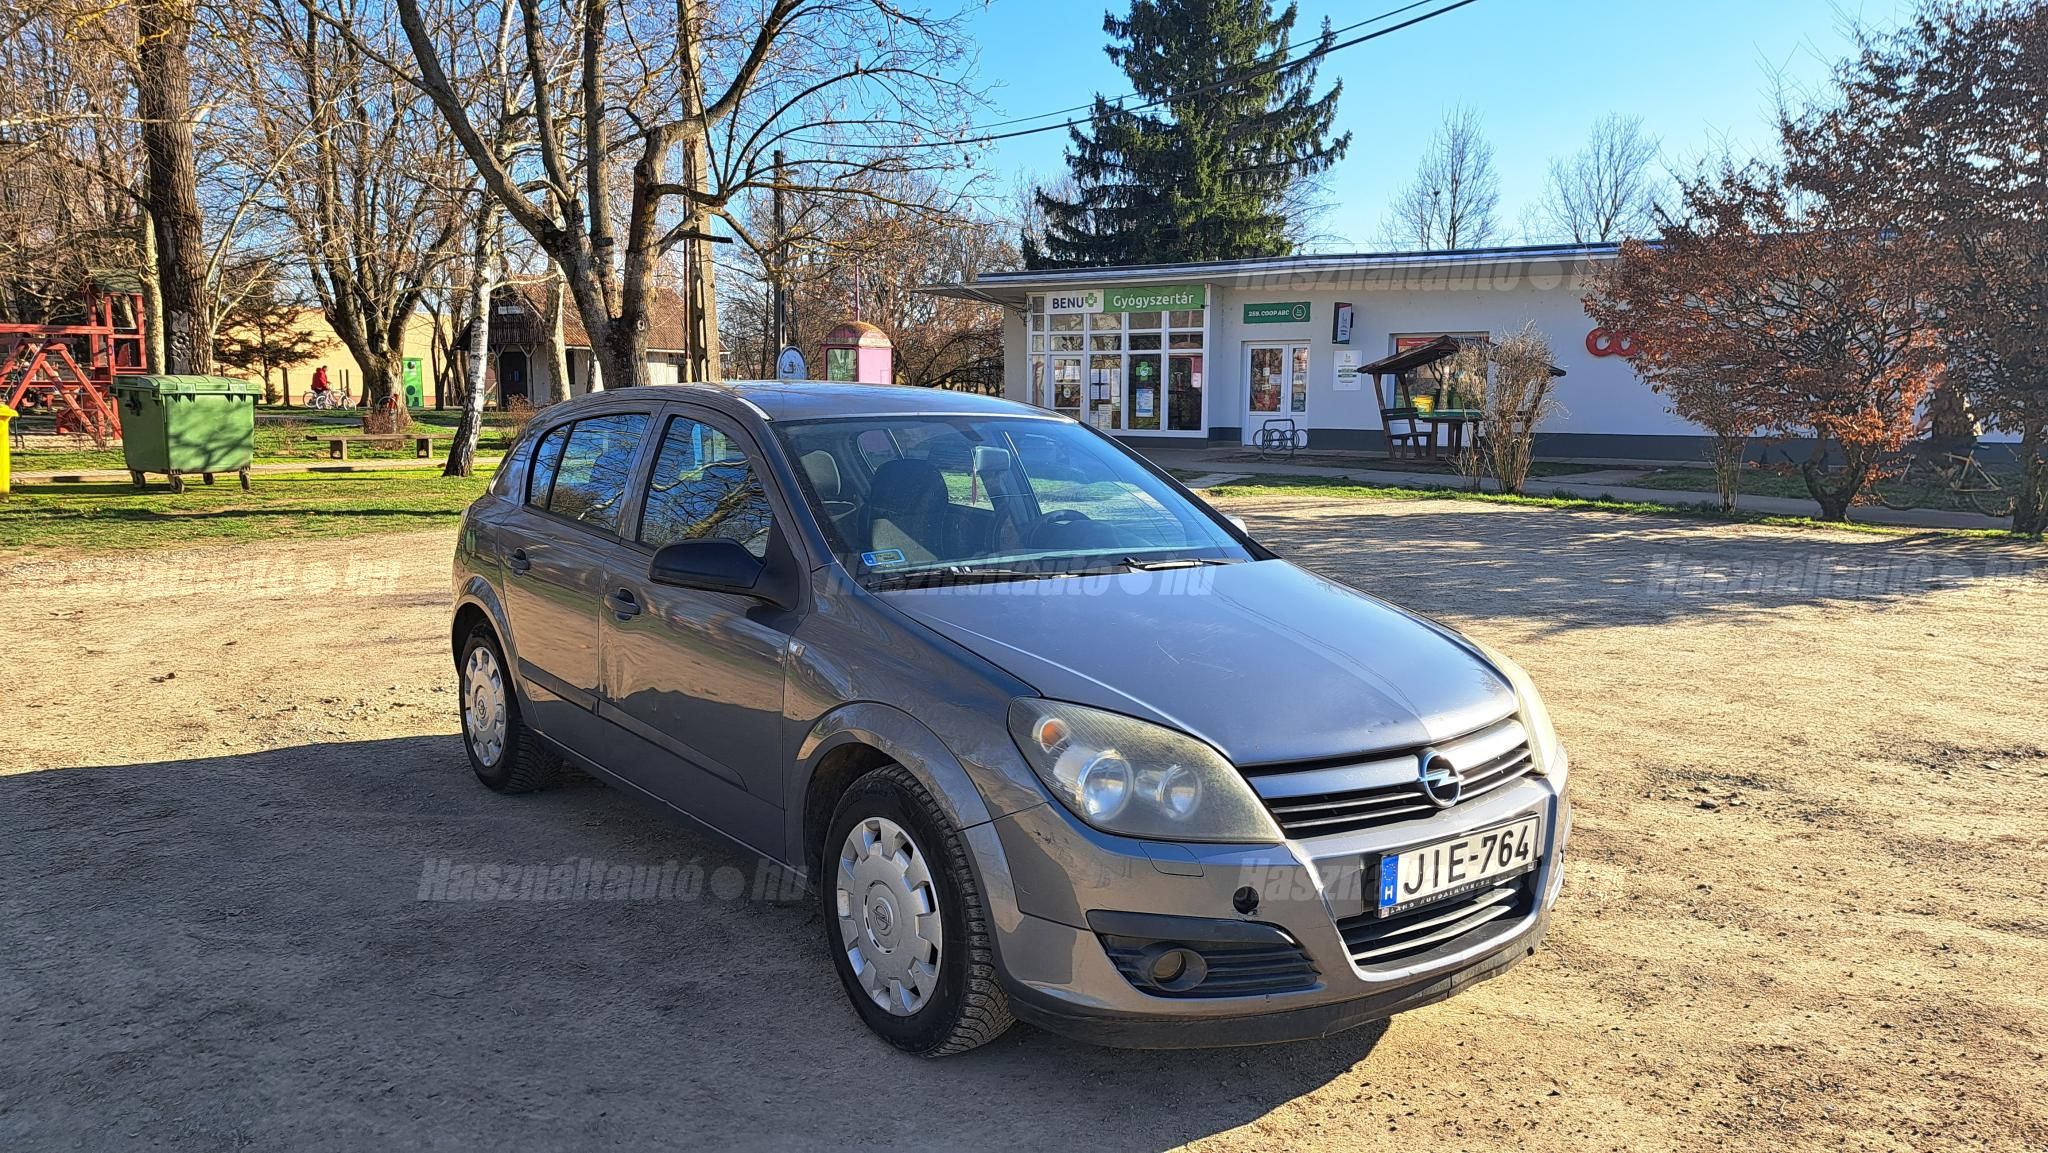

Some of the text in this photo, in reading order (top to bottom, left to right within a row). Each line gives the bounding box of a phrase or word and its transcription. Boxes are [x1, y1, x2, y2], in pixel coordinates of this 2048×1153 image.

[1052, 297, 1084, 309] BENU
[1113, 292, 1194, 309] Gyógyszertár
[1403, 825, 1529, 895] JIE-764
[1384, 885, 1393, 900] H
